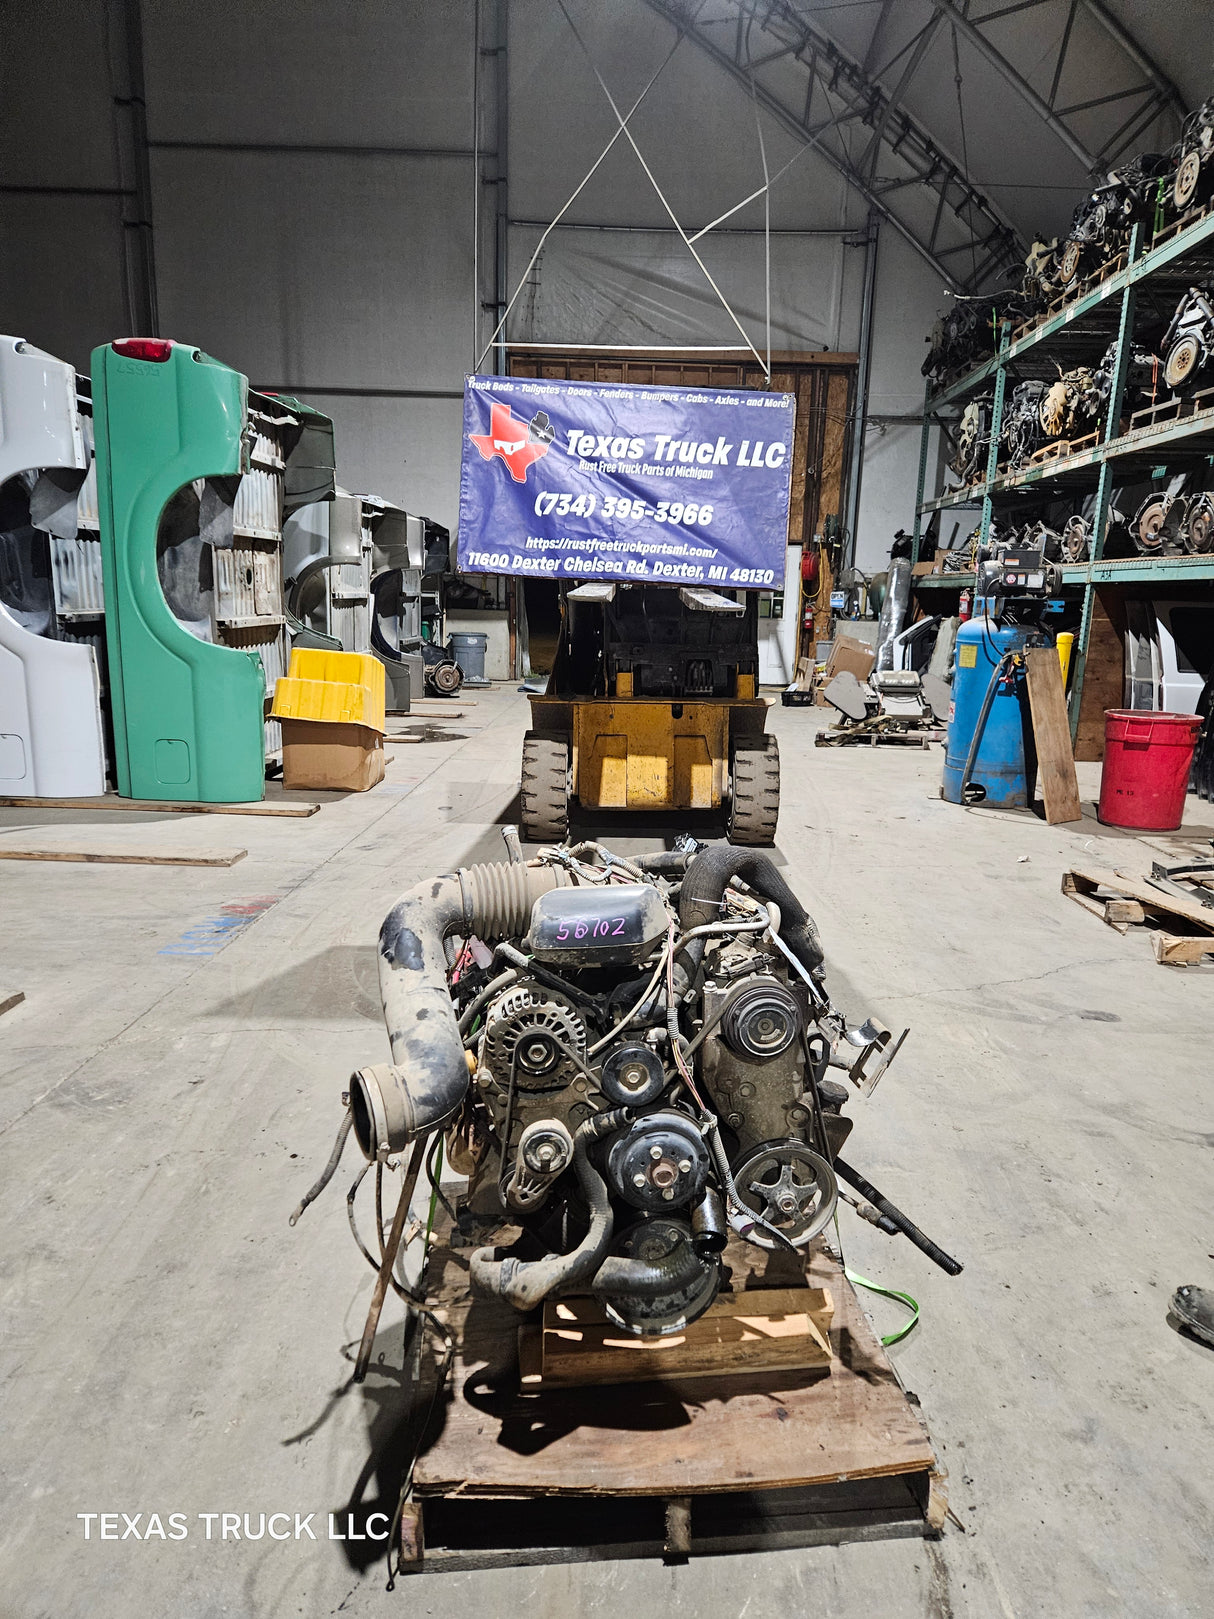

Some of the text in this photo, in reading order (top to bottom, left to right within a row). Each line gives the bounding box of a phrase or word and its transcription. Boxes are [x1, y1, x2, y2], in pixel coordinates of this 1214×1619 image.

[468, 380, 491, 390] Truck
[493, 382, 513, 391] Beds
[522, 384, 559, 394] Tailgates
[568, 387, 591, 397] Doors
[600, 389, 633, 399] Fenders
[641, 392, 678, 402] Bumpers
[686, 394, 707, 403] Cabs
[715, 396, 739, 406] Axles
[747, 398, 763, 407] and
[764, 399, 790, 408] More!
[567, 429, 786, 468] Texas Truck LLC
[579, 460, 713, 480] Rust Free Truck Parts of Michigan
[534, 491, 714, 526] (734) 395-3966
[525, 536, 718, 558] https://rustfreetruckpartsmi.com/
[468, 552, 774, 584] 11600 Dexter Chelsea Rd. Dexter, MI 48130
